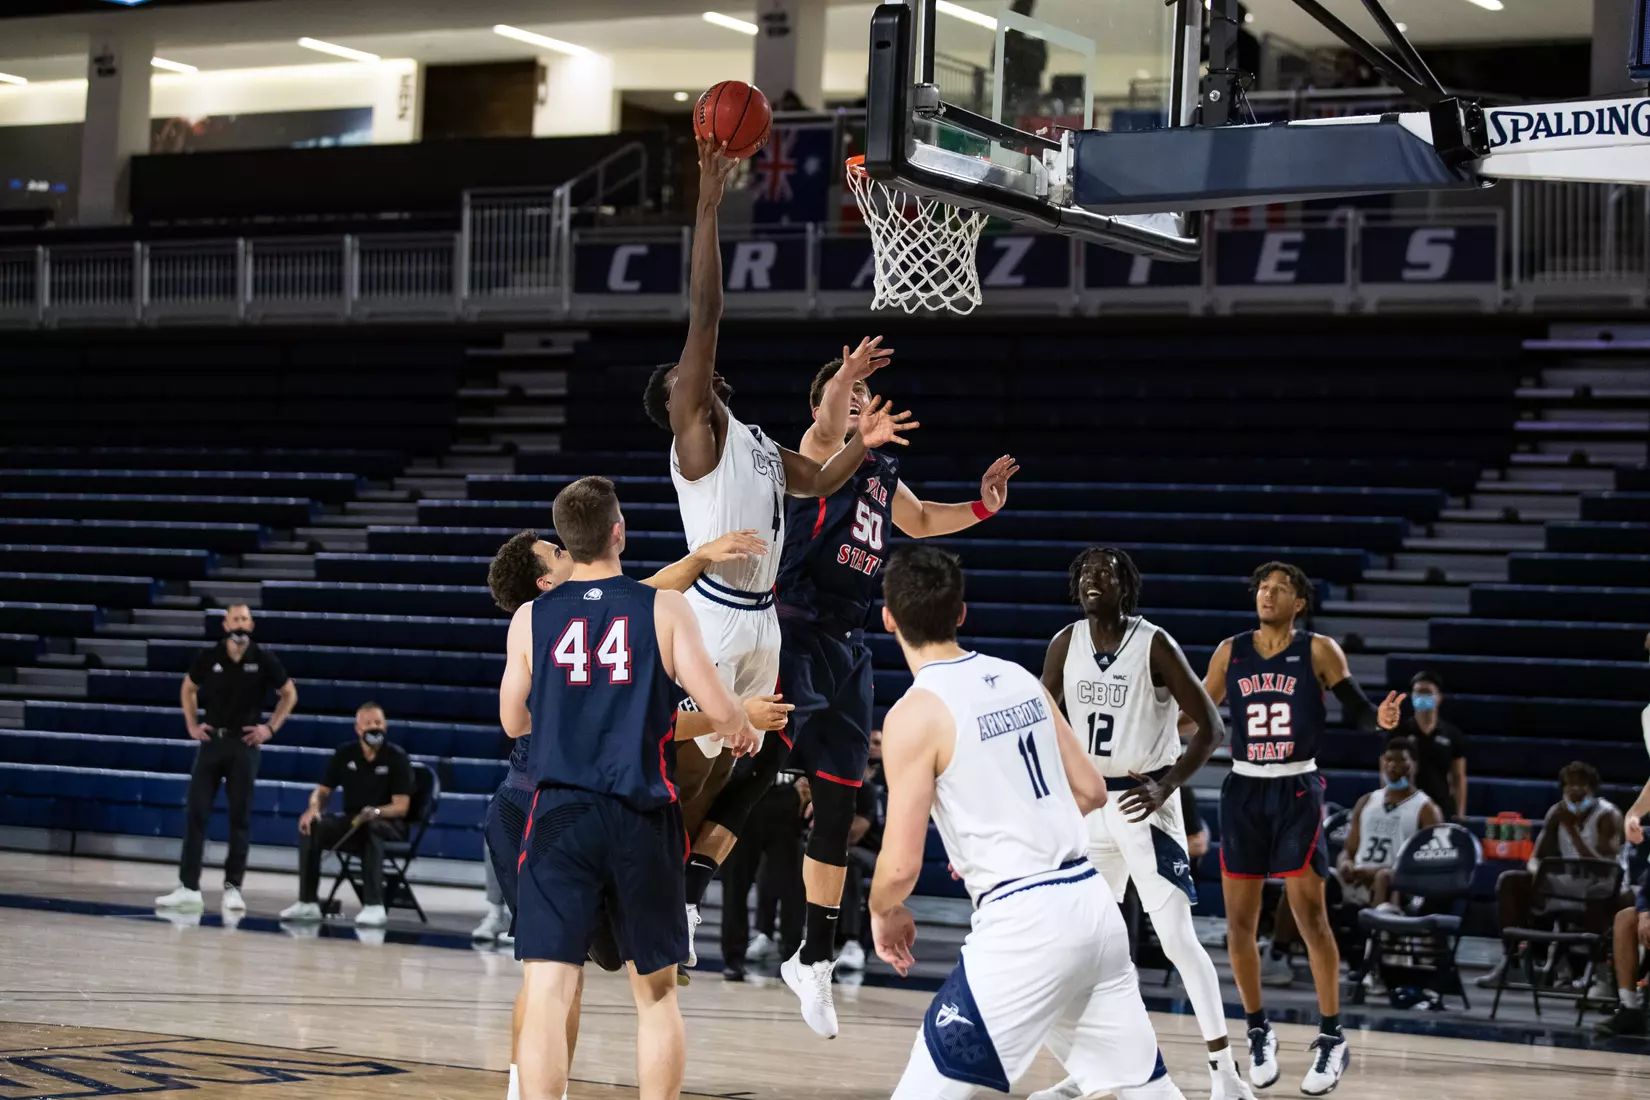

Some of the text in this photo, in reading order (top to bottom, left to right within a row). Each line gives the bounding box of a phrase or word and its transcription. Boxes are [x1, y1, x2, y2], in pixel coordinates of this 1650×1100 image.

[1489, 100, 1650, 148] SPALDING
[852, 499, 884, 552] 50
[837, 544, 883, 578] STAT
[551, 616, 632, 685] 44
[1077, 680, 1128, 708] CBU
[1237, 673, 1297, 697] DIXIE
[1087, 711, 1114, 757] 12
[1246, 702, 1292, 737] 22
[1018, 730, 1051, 799] 11
[1362, 836, 1392, 863] 35
